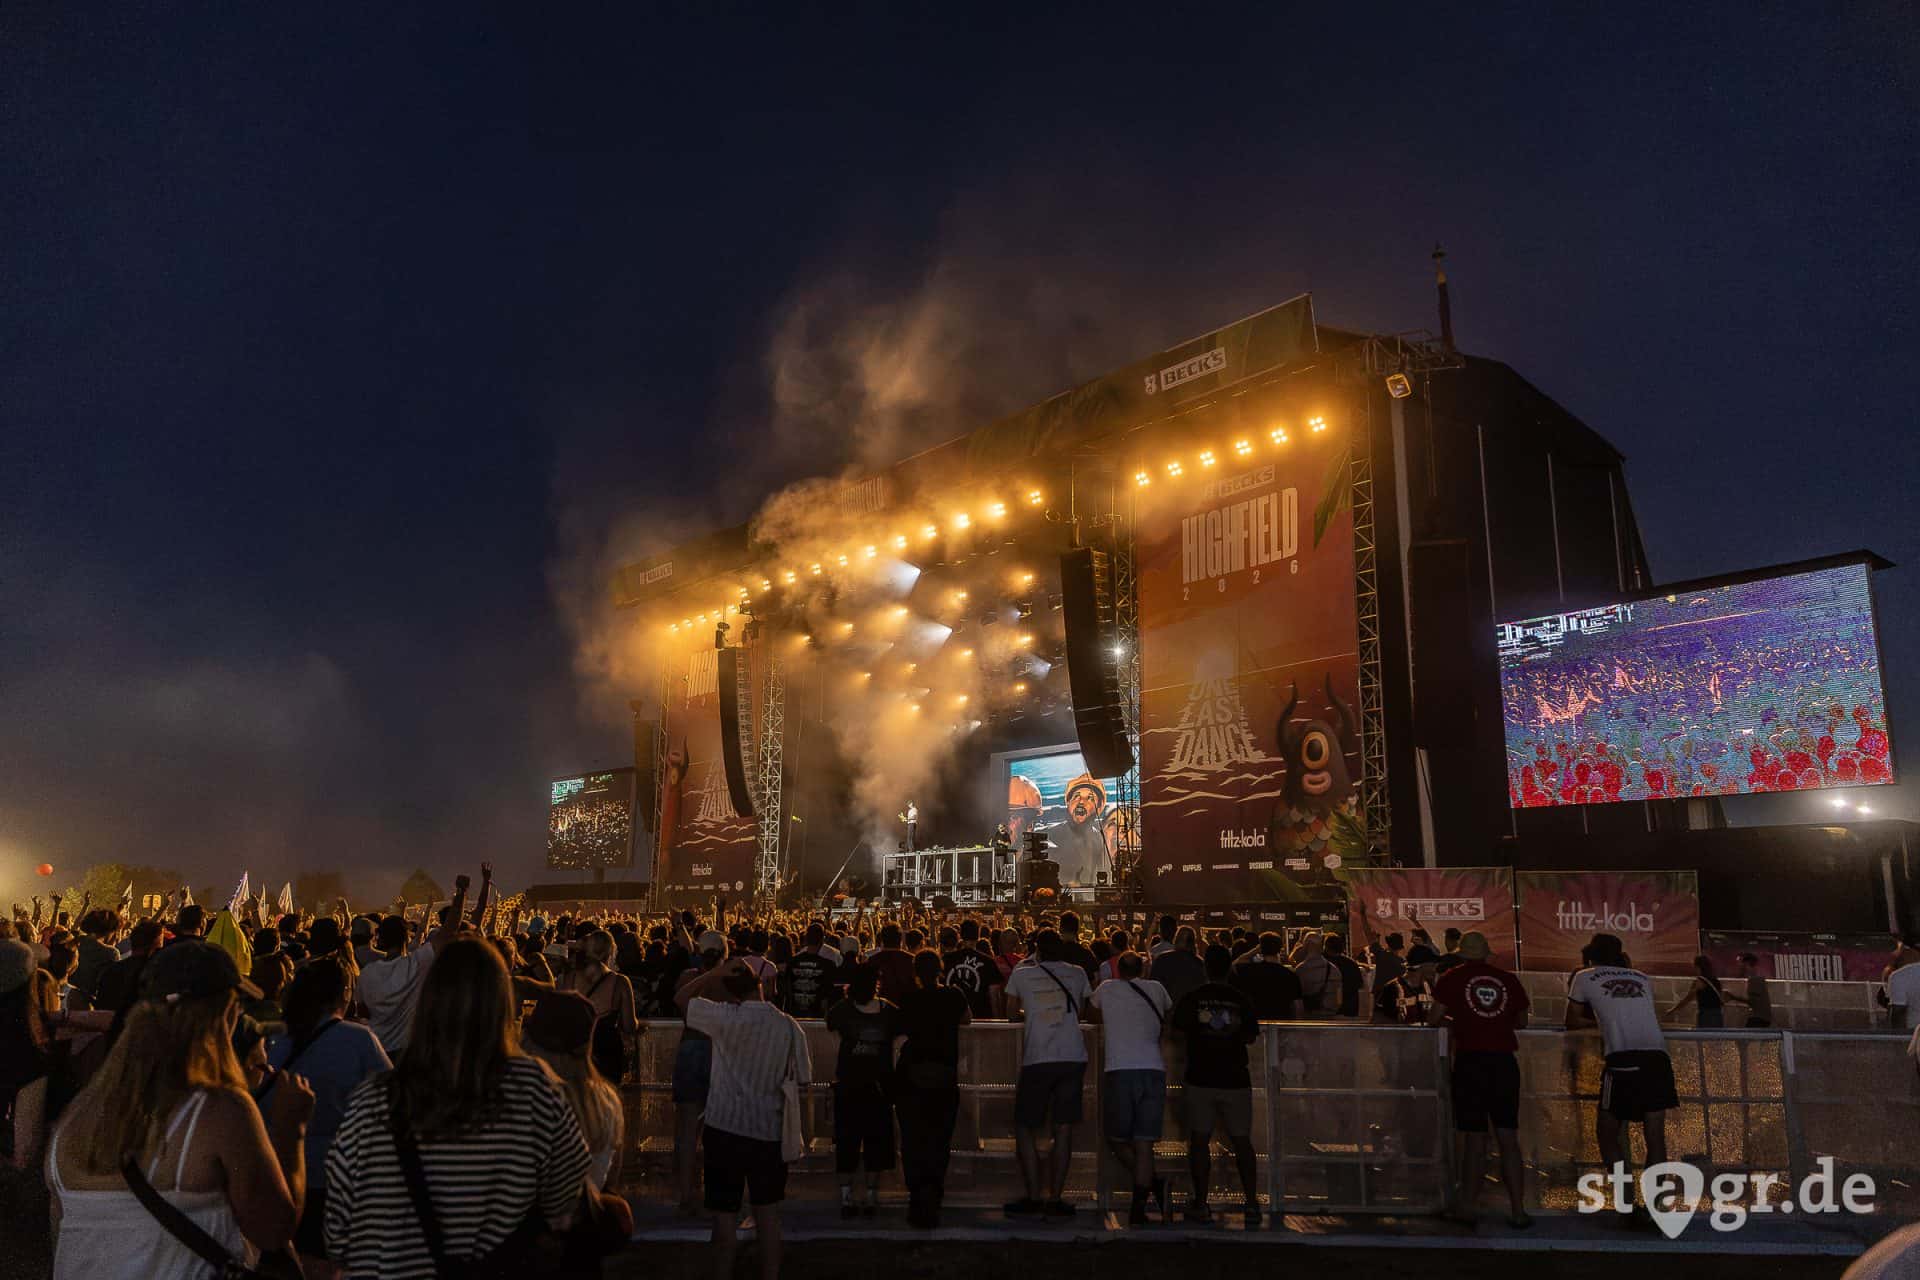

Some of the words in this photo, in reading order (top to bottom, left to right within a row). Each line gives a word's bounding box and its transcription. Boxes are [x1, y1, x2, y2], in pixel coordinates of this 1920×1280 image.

[1163, 351, 1223, 387] BECK'S
[1182, 487, 1299, 585] HIGHFIELD
[1403, 902, 1482, 918] BECK'S
[1557, 901, 1654, 932] fritz-kola
[1774, 953, 1844, 981] HIGHFIELD
